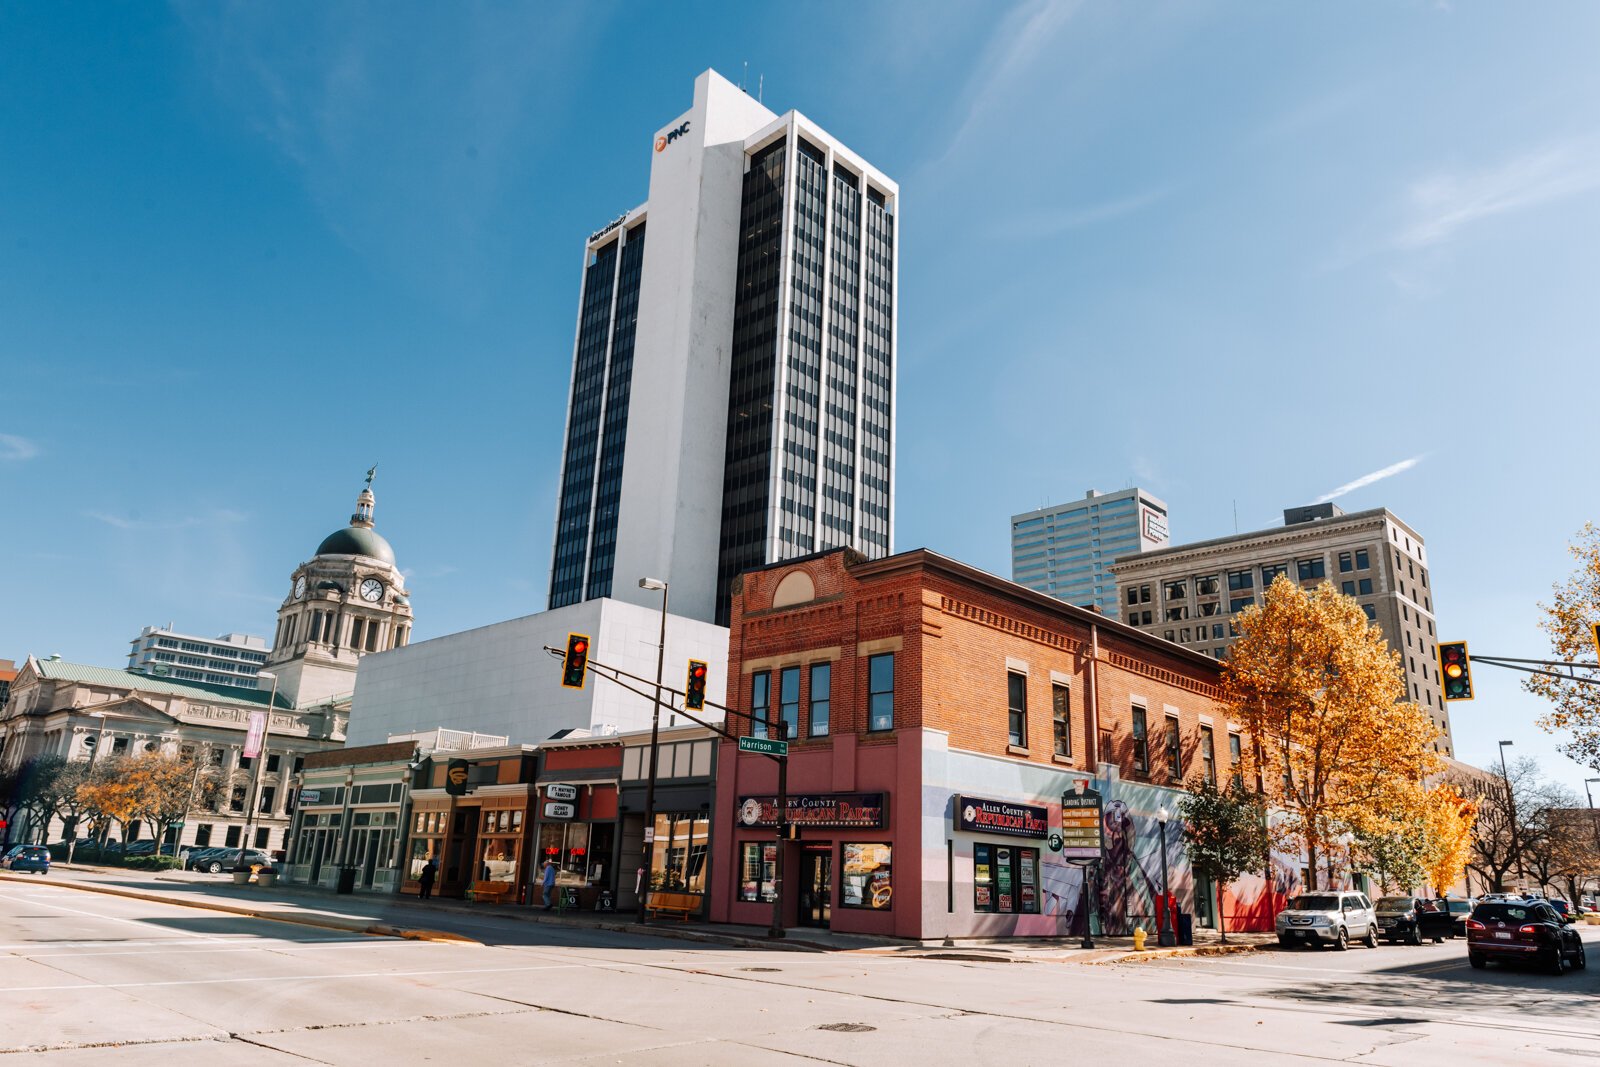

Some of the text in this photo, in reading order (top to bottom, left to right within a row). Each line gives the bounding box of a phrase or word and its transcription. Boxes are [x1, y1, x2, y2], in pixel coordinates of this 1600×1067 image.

[667, 121, 690, 144] PNC
[741, 740, 772, 750] Harrison
[772, 797, 836, 808] AEN COUNTY
[1064, 798, 1097, 806] LANDING DISTRICT
[839, 802, 881, 821] PARTY
[982, 802, 1024, 817] ALLEN COUNTY
[975, 806, 1047, 831] REPUBLICAN PARTY
[1052, 839, 1058, 847] P
